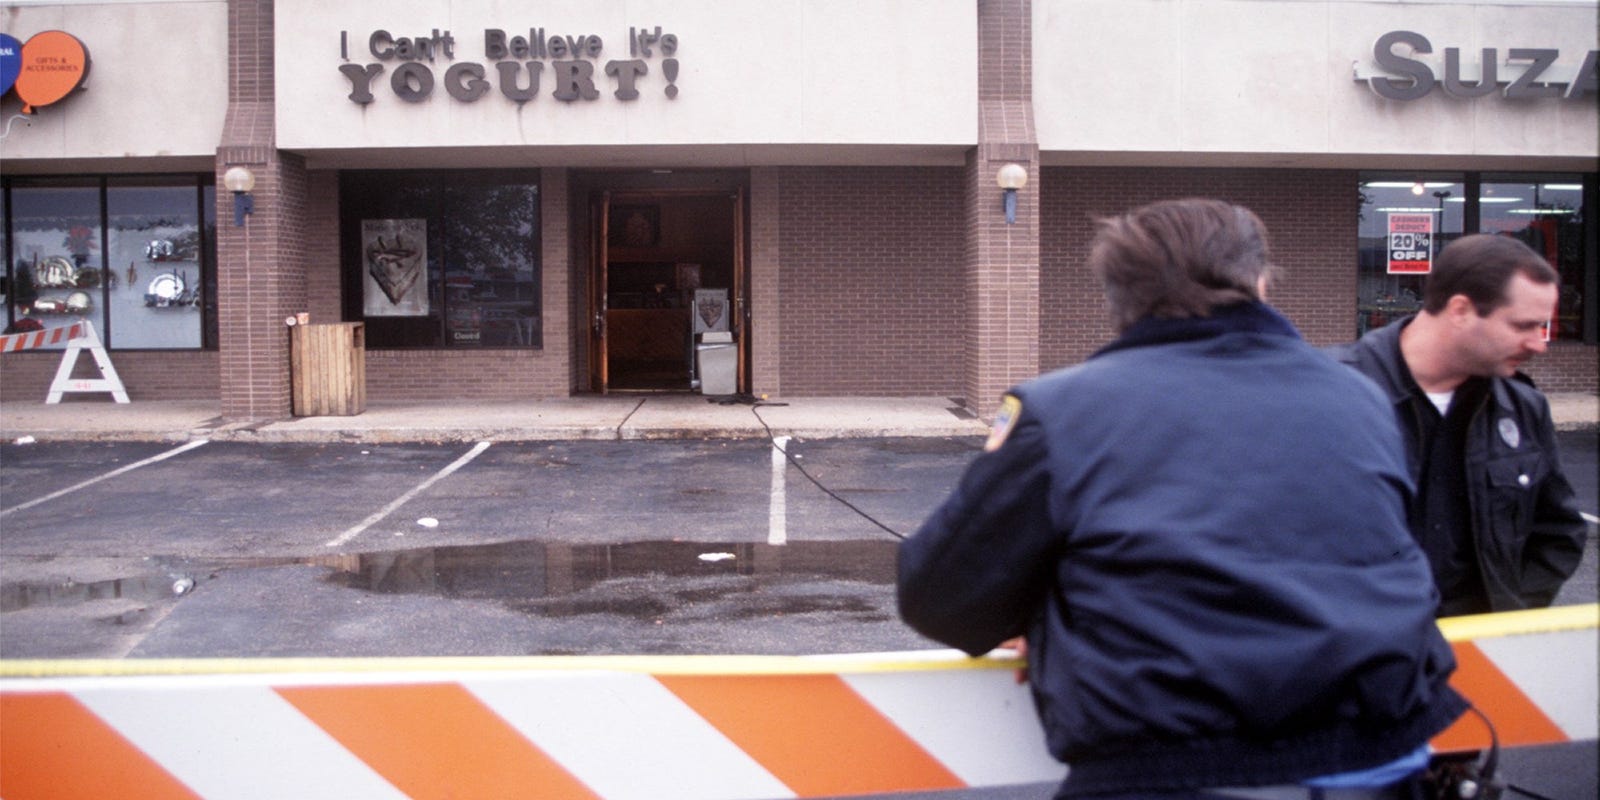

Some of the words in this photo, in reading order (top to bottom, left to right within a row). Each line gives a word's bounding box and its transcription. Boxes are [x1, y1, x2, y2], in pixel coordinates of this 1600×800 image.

[340, 30, 348, 60] I
[369, 28, 456, 61] Can't
[484, 27, 603, 59] Believe
[629, 26, 678, 59] It's
[35, 56, 58, 64] GIFTS
[26, 64, 79, 72] ACCESSORIES
[338, 58, 680, 103] YOGURT!
[1392, 251, 1427, 260] OFF
